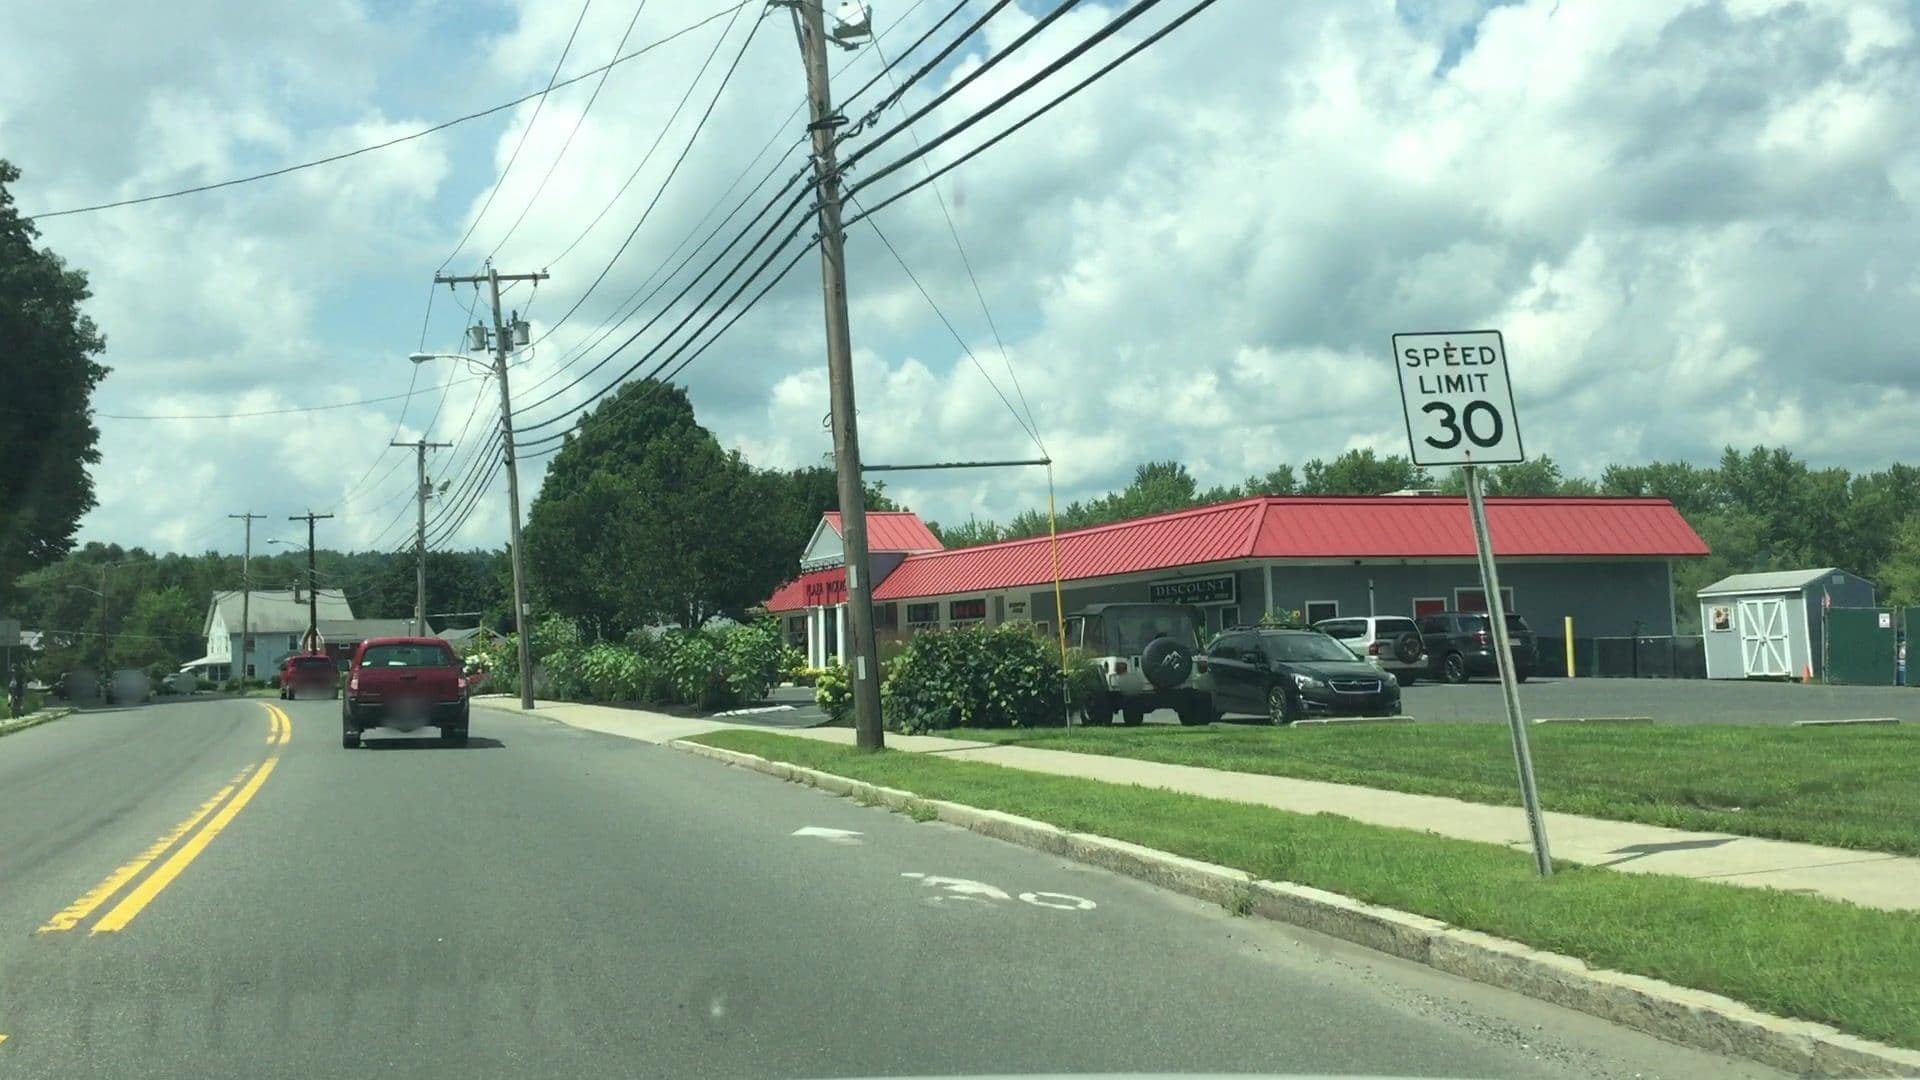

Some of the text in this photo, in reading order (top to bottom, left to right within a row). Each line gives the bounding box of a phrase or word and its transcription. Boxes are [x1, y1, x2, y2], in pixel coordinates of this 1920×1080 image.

[1405, 346, 1496, 368] SPEED
[1419, 373, 1488, 394] LIMIT
[1422, 400, 1503, 449] 30
[1156, 580, 1226, 597] DISCOUNT
